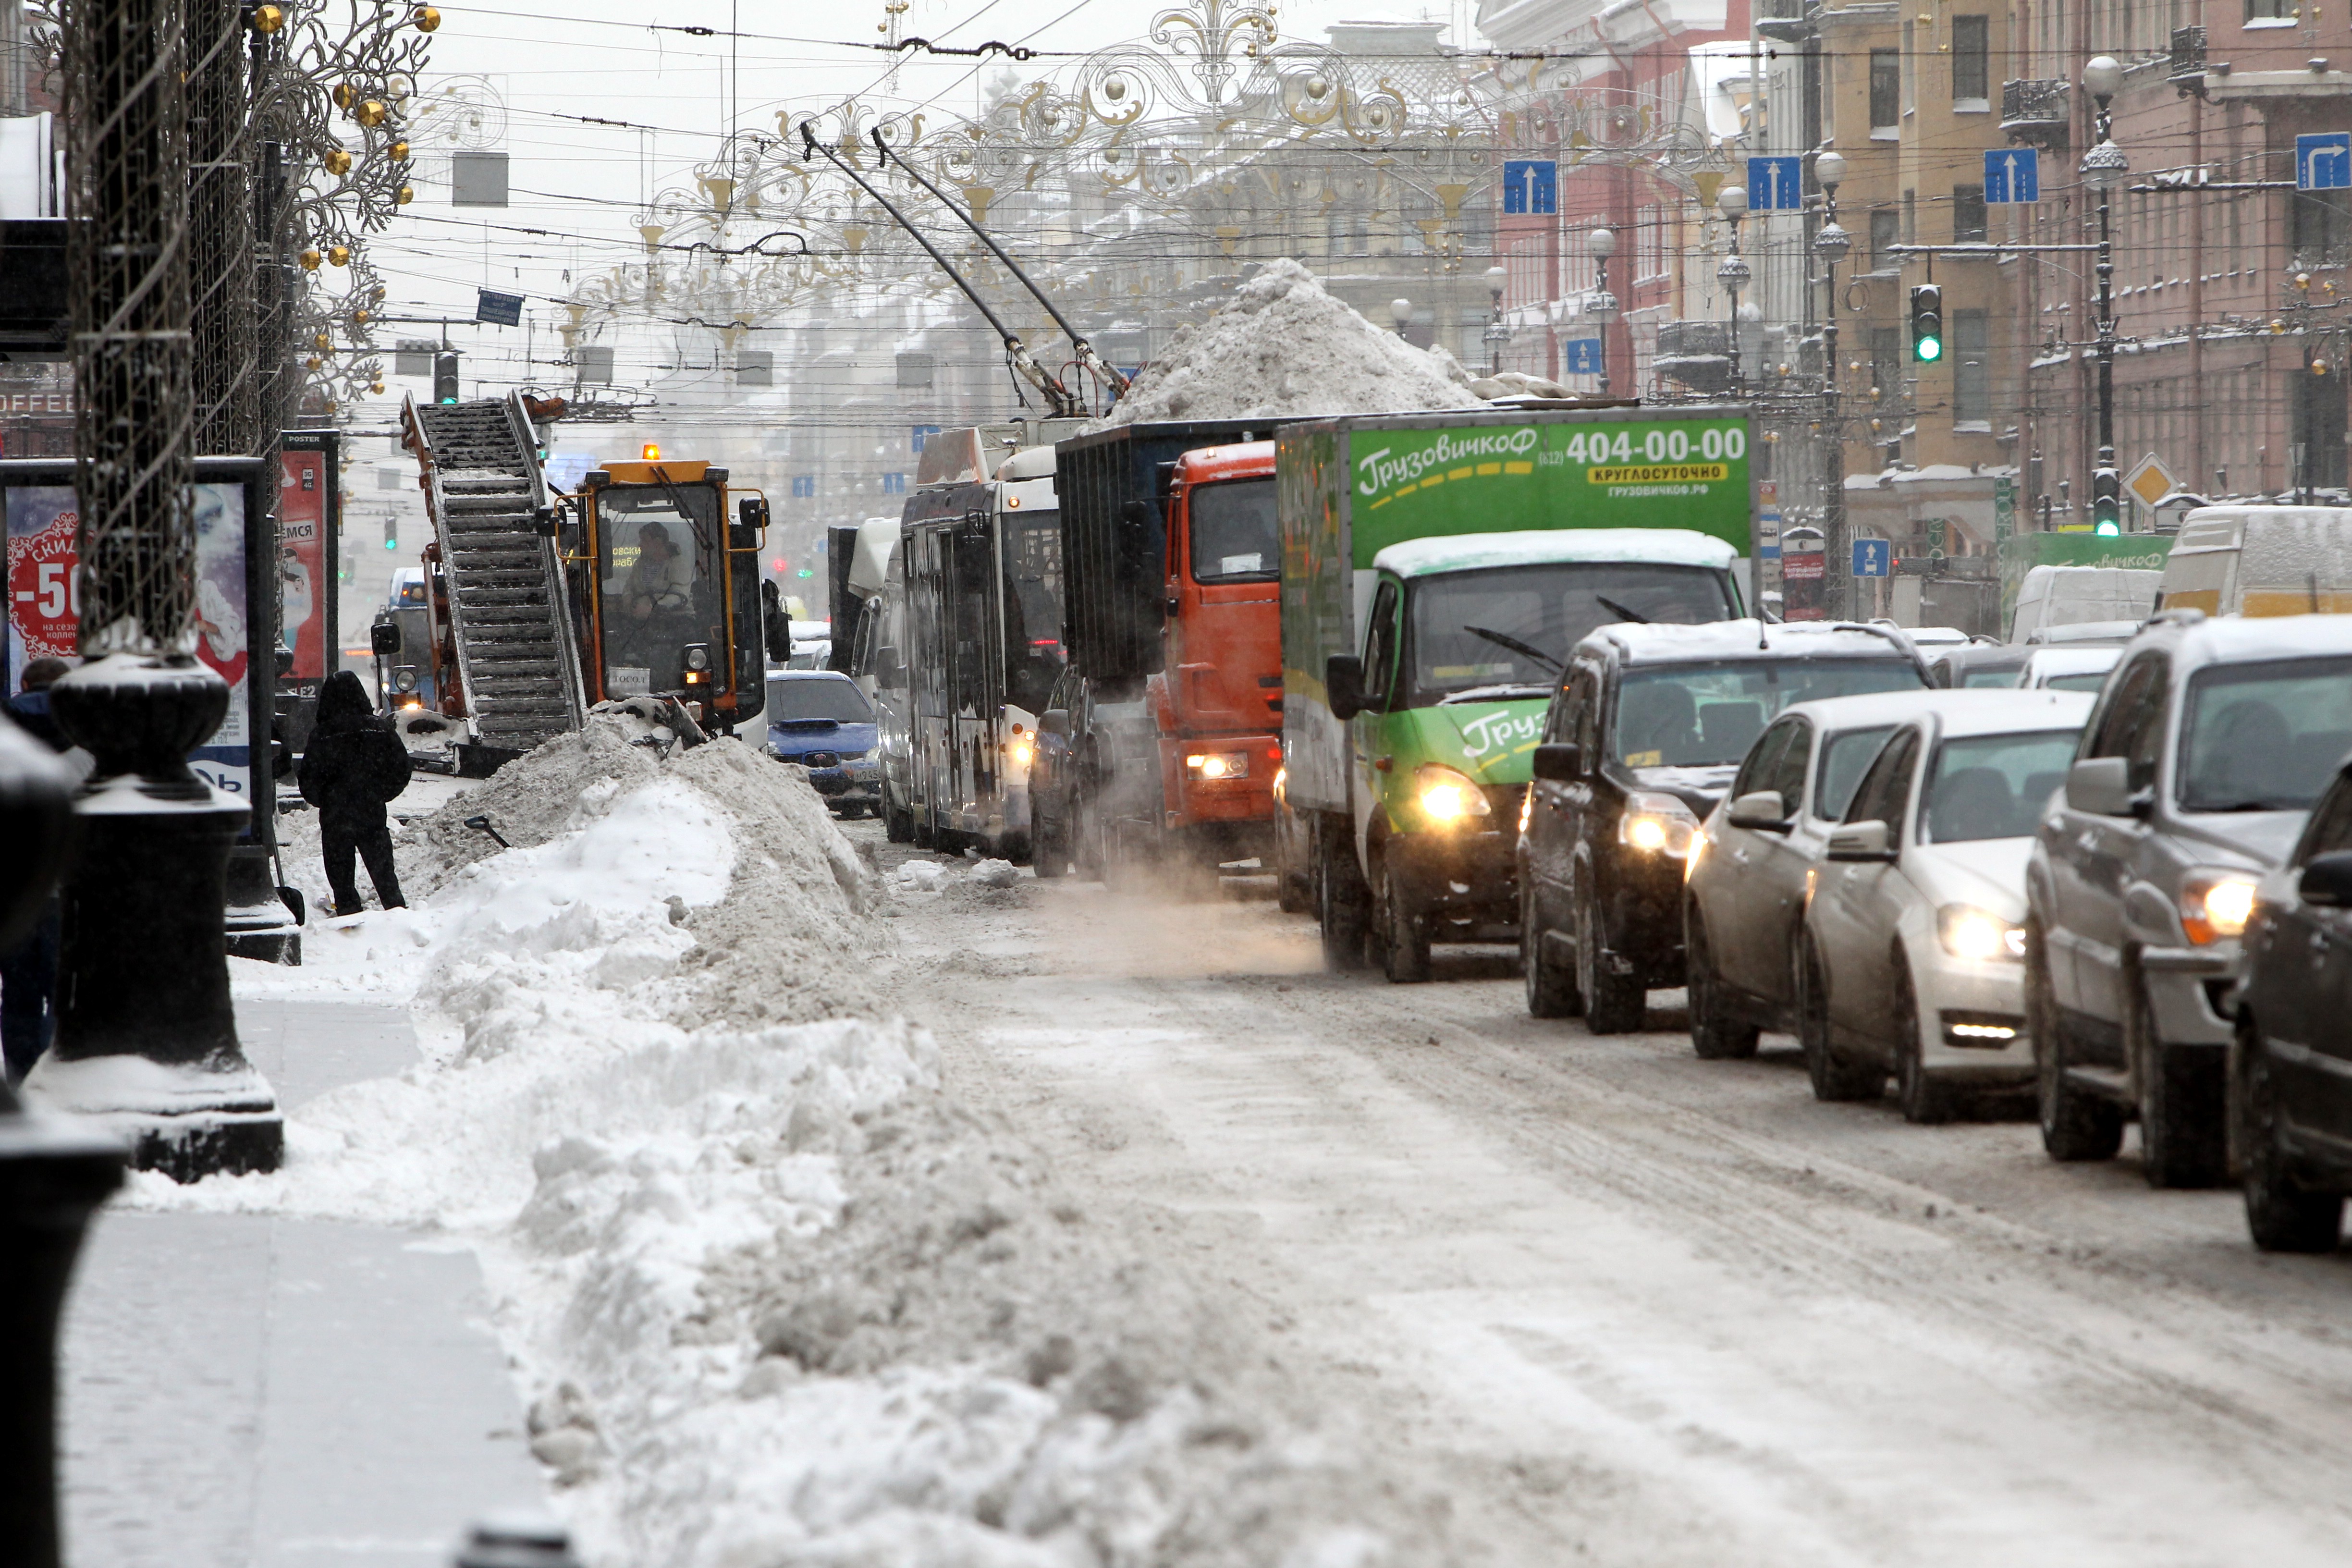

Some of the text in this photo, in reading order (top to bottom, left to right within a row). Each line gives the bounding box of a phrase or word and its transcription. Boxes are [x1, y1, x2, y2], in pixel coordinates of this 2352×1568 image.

[1567, 428, 1745, 464] 404-00-00
[1595, 465, 1720, 481] КРУГЛОСУТОЧНО
[1608, 483, 1709, 497] ГРУЗОВИЧКОФ.РФ
